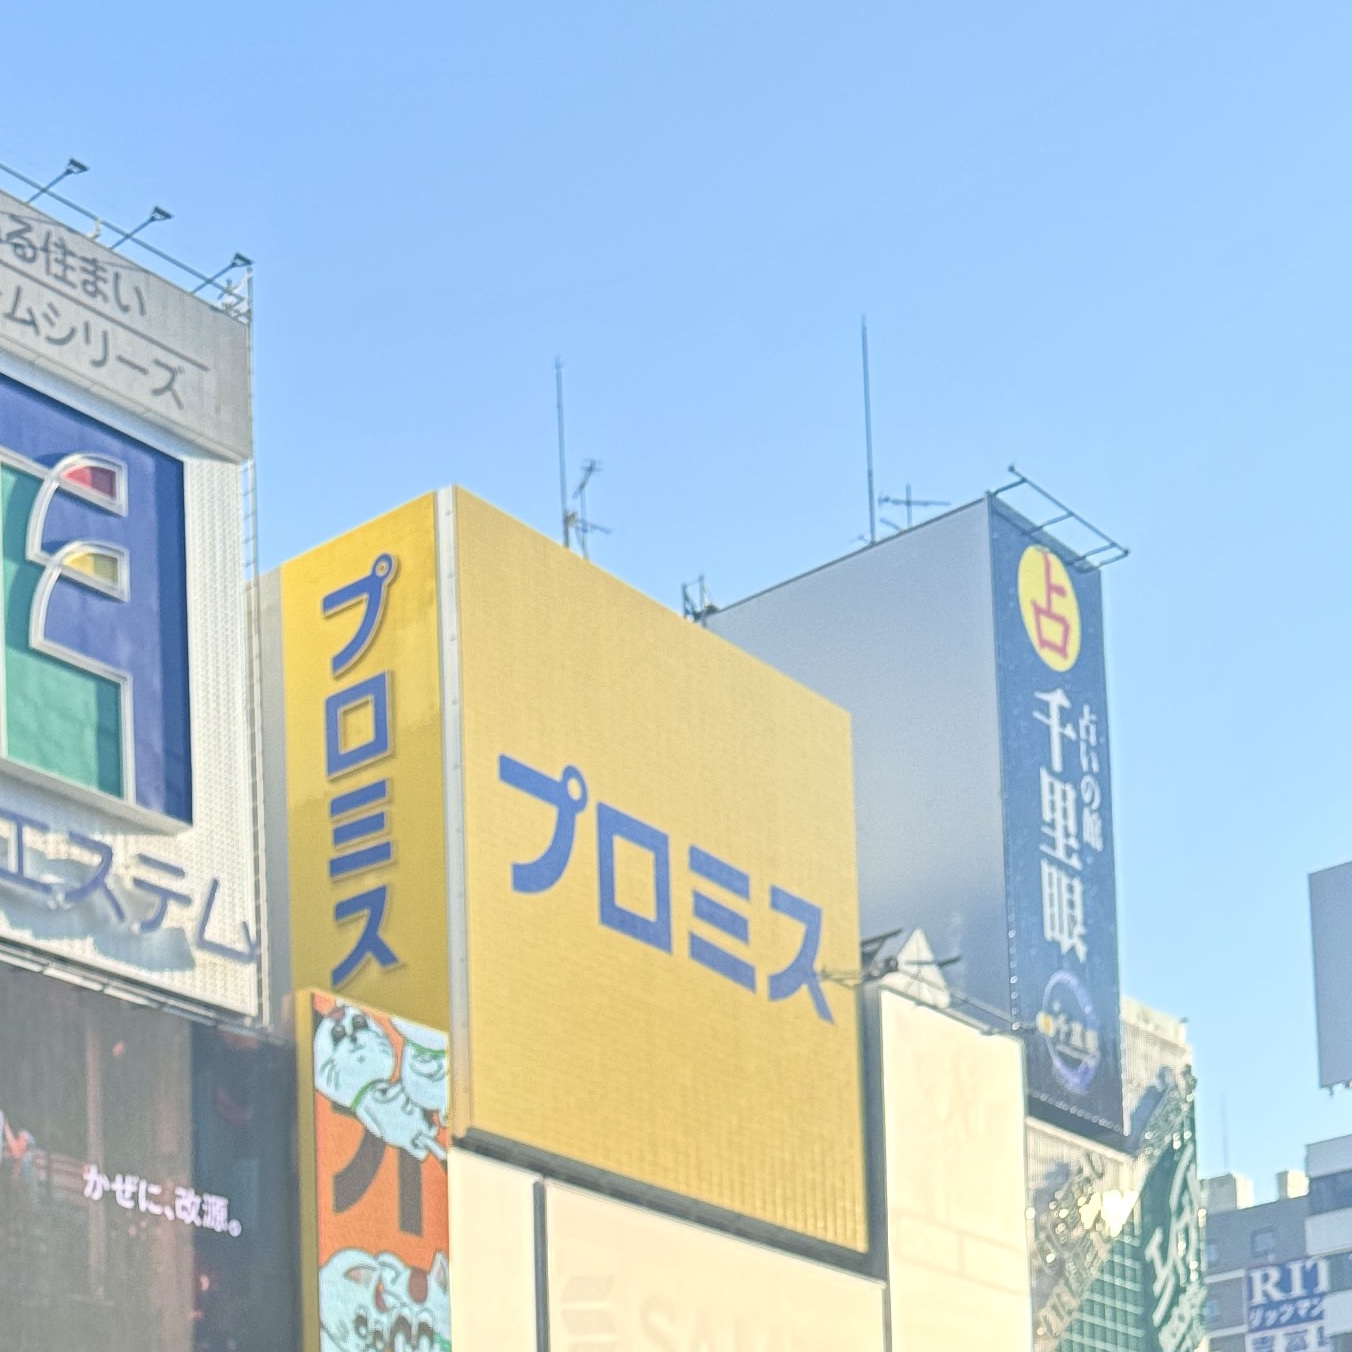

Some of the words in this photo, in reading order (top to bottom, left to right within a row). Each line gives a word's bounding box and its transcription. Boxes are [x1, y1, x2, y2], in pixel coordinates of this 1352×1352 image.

[1030, 549, 1070, 660] 占
[322, 553, 406, 990] プロミス
[498, 753, 835, 1026] プロミス
